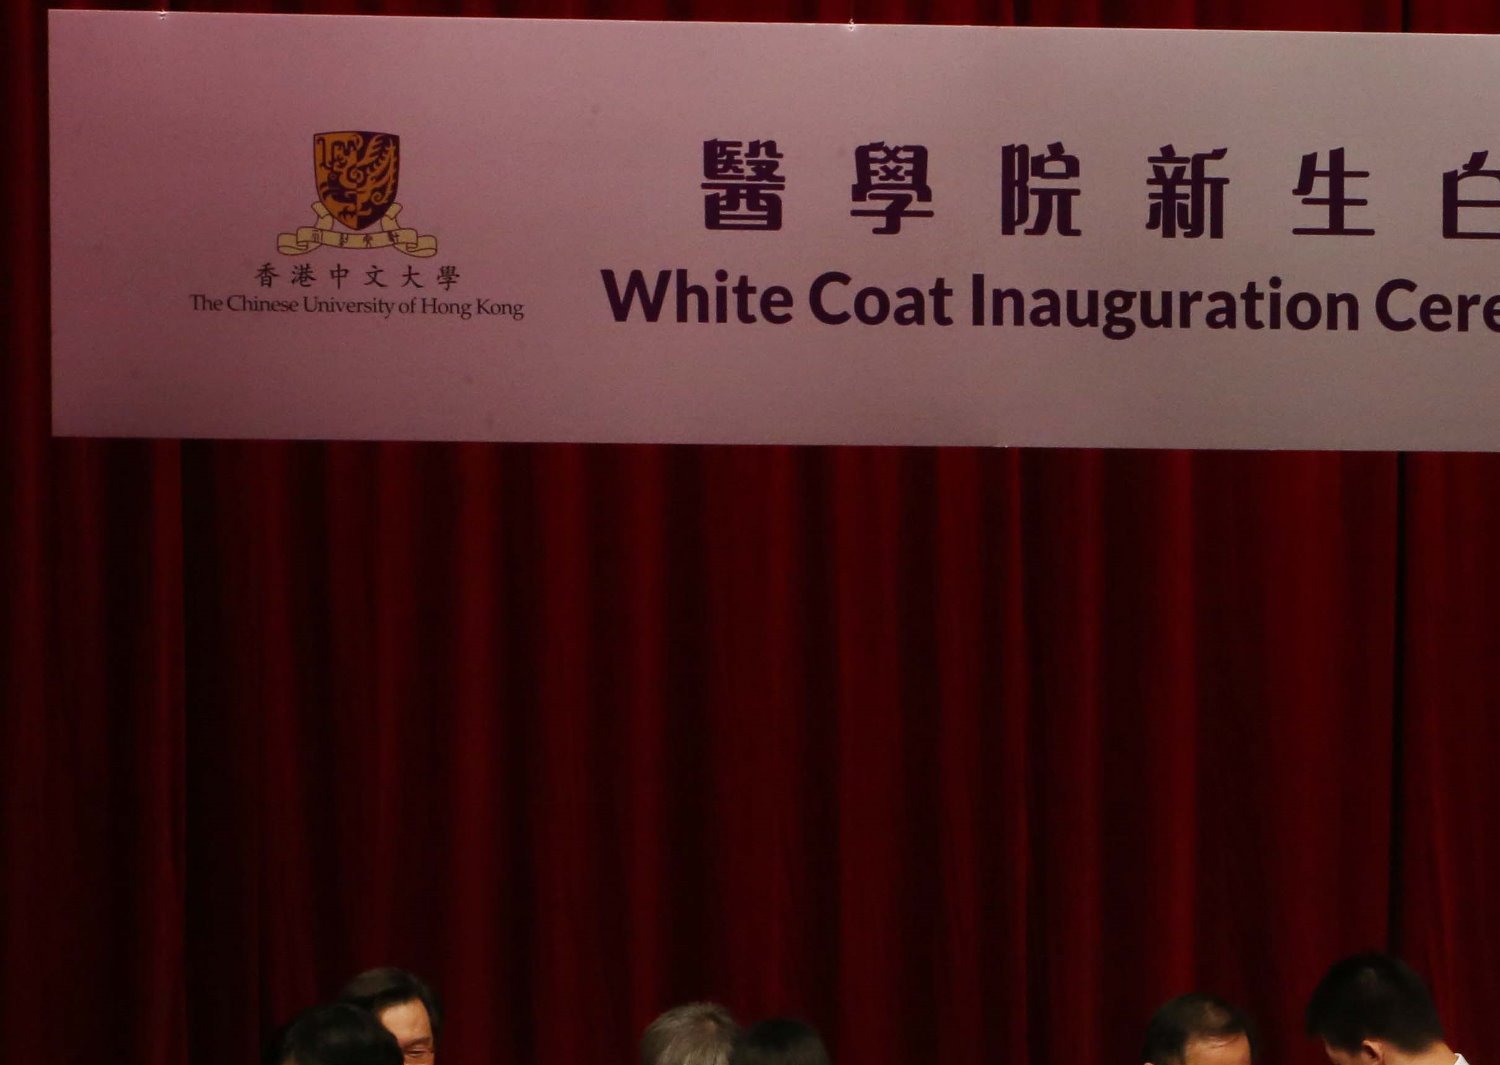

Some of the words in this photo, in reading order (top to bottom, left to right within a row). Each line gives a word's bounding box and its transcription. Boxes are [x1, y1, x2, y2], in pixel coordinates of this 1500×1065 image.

[253, 262, 461, 292] 香港中文大學
[189, 294, 223, 312] The
[227, 295, 299, 313] Chinese
[303, 296, 396, 318] University
[398, 297, 418, 314] of
[421, 298, 471, 320] Hong
[476, 299, 525, 320] Kong
[600, 268, 794, 325] White
[808, 271, 954, 327] Coat
[972, 273, 1359, 341] Inauguration
